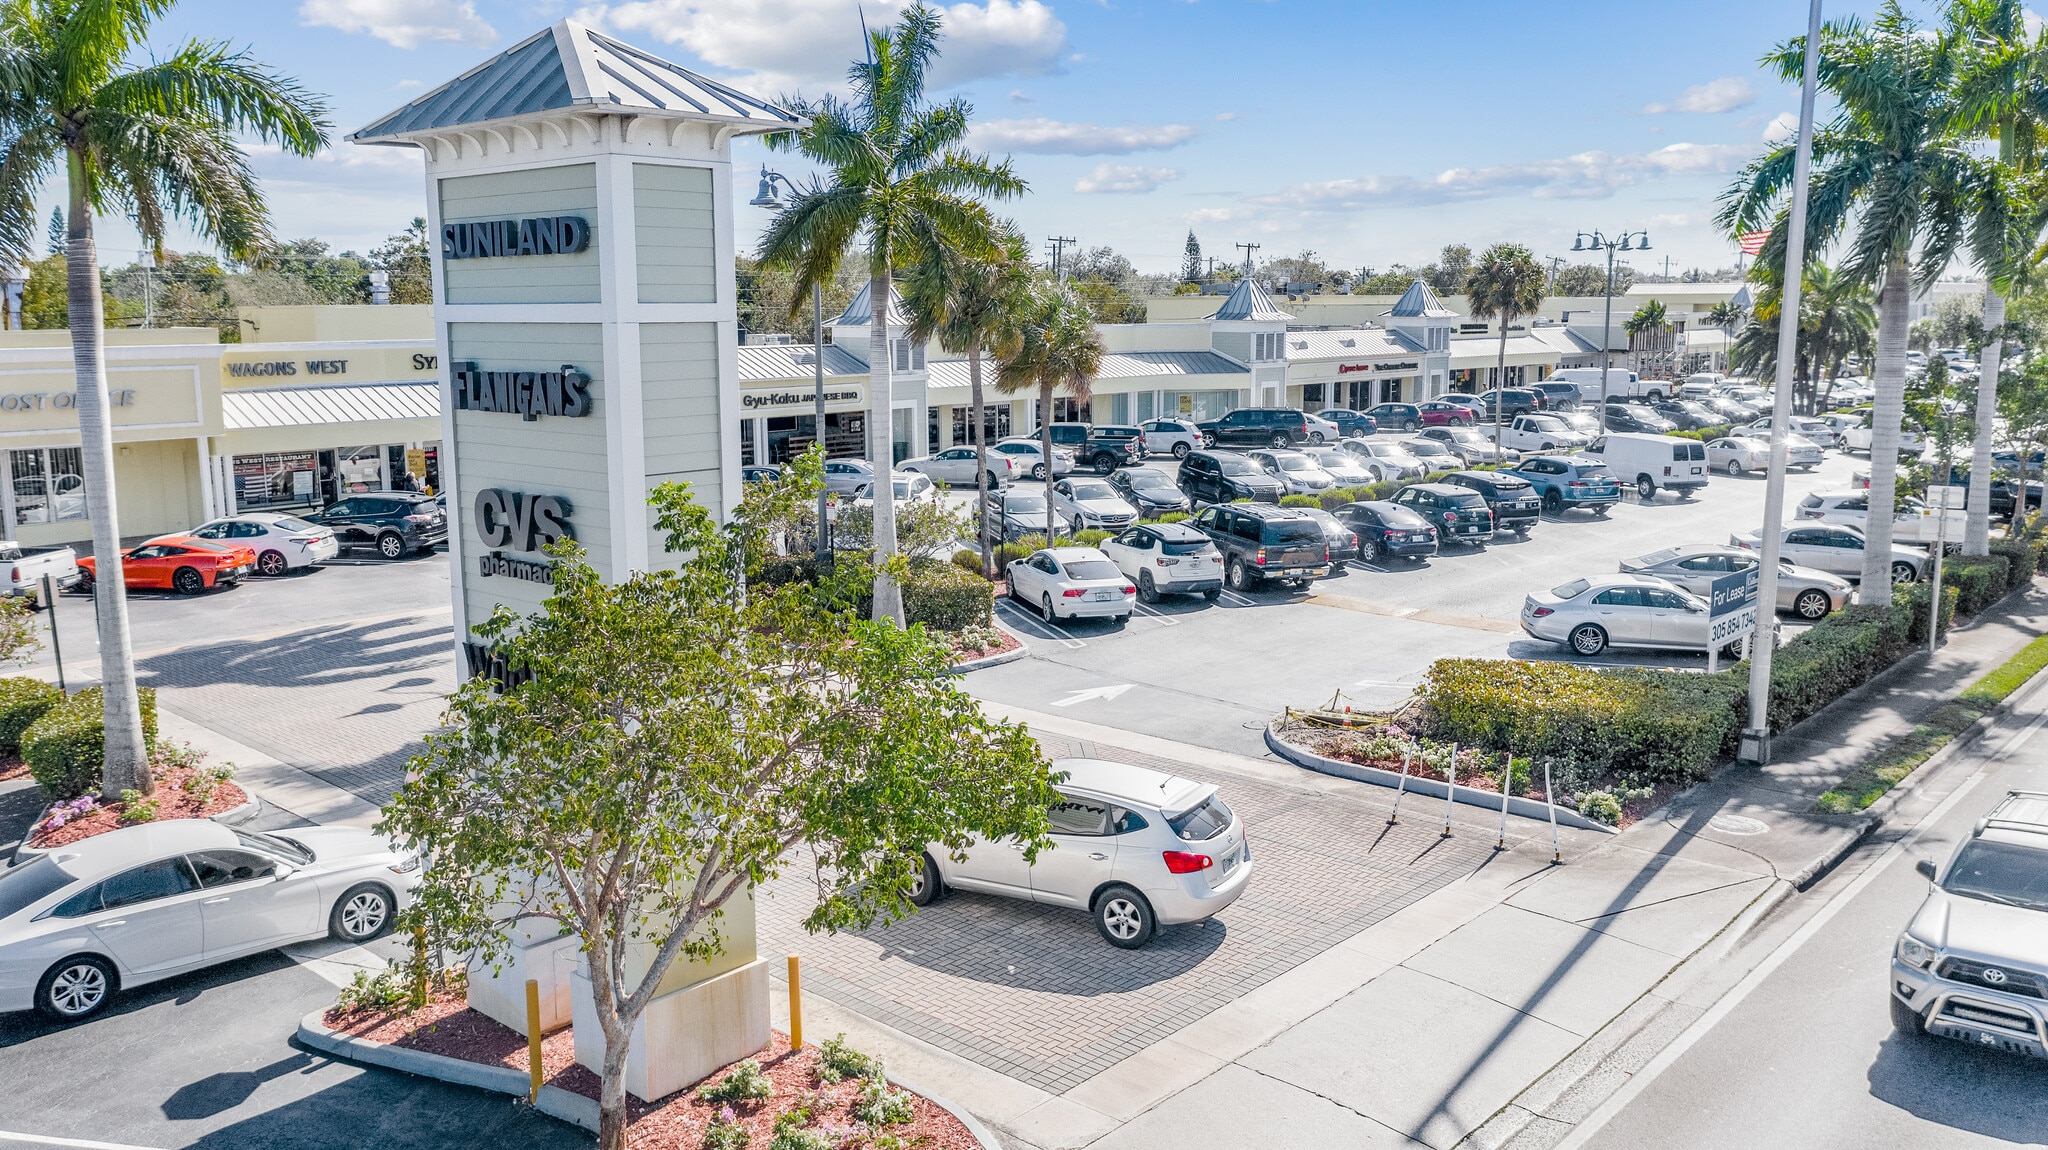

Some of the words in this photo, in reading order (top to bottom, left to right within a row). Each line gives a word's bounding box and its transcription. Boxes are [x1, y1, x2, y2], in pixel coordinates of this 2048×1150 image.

[441, 216, 590, 259] SUNILAND
[227, 361, 297, 377] WAGONS
[305, 359, 348, 375] WEST
[0, 393, 51, 411] OST
[743, 392, 800, 409] Gyu-Kaku
[801, 392, 841, 402] JAPNESE
[841, 391, 858, 399] BBQ
[474, 488, 575, 558] CVS
[479, 551, 555, 585] pharmac
[1713, 590, 1726, 607] For
[1726, 585, 1745, 602] Lease
[1711, 621, 1726, 642] 305
[1727, 616, 1740, 635] 854
